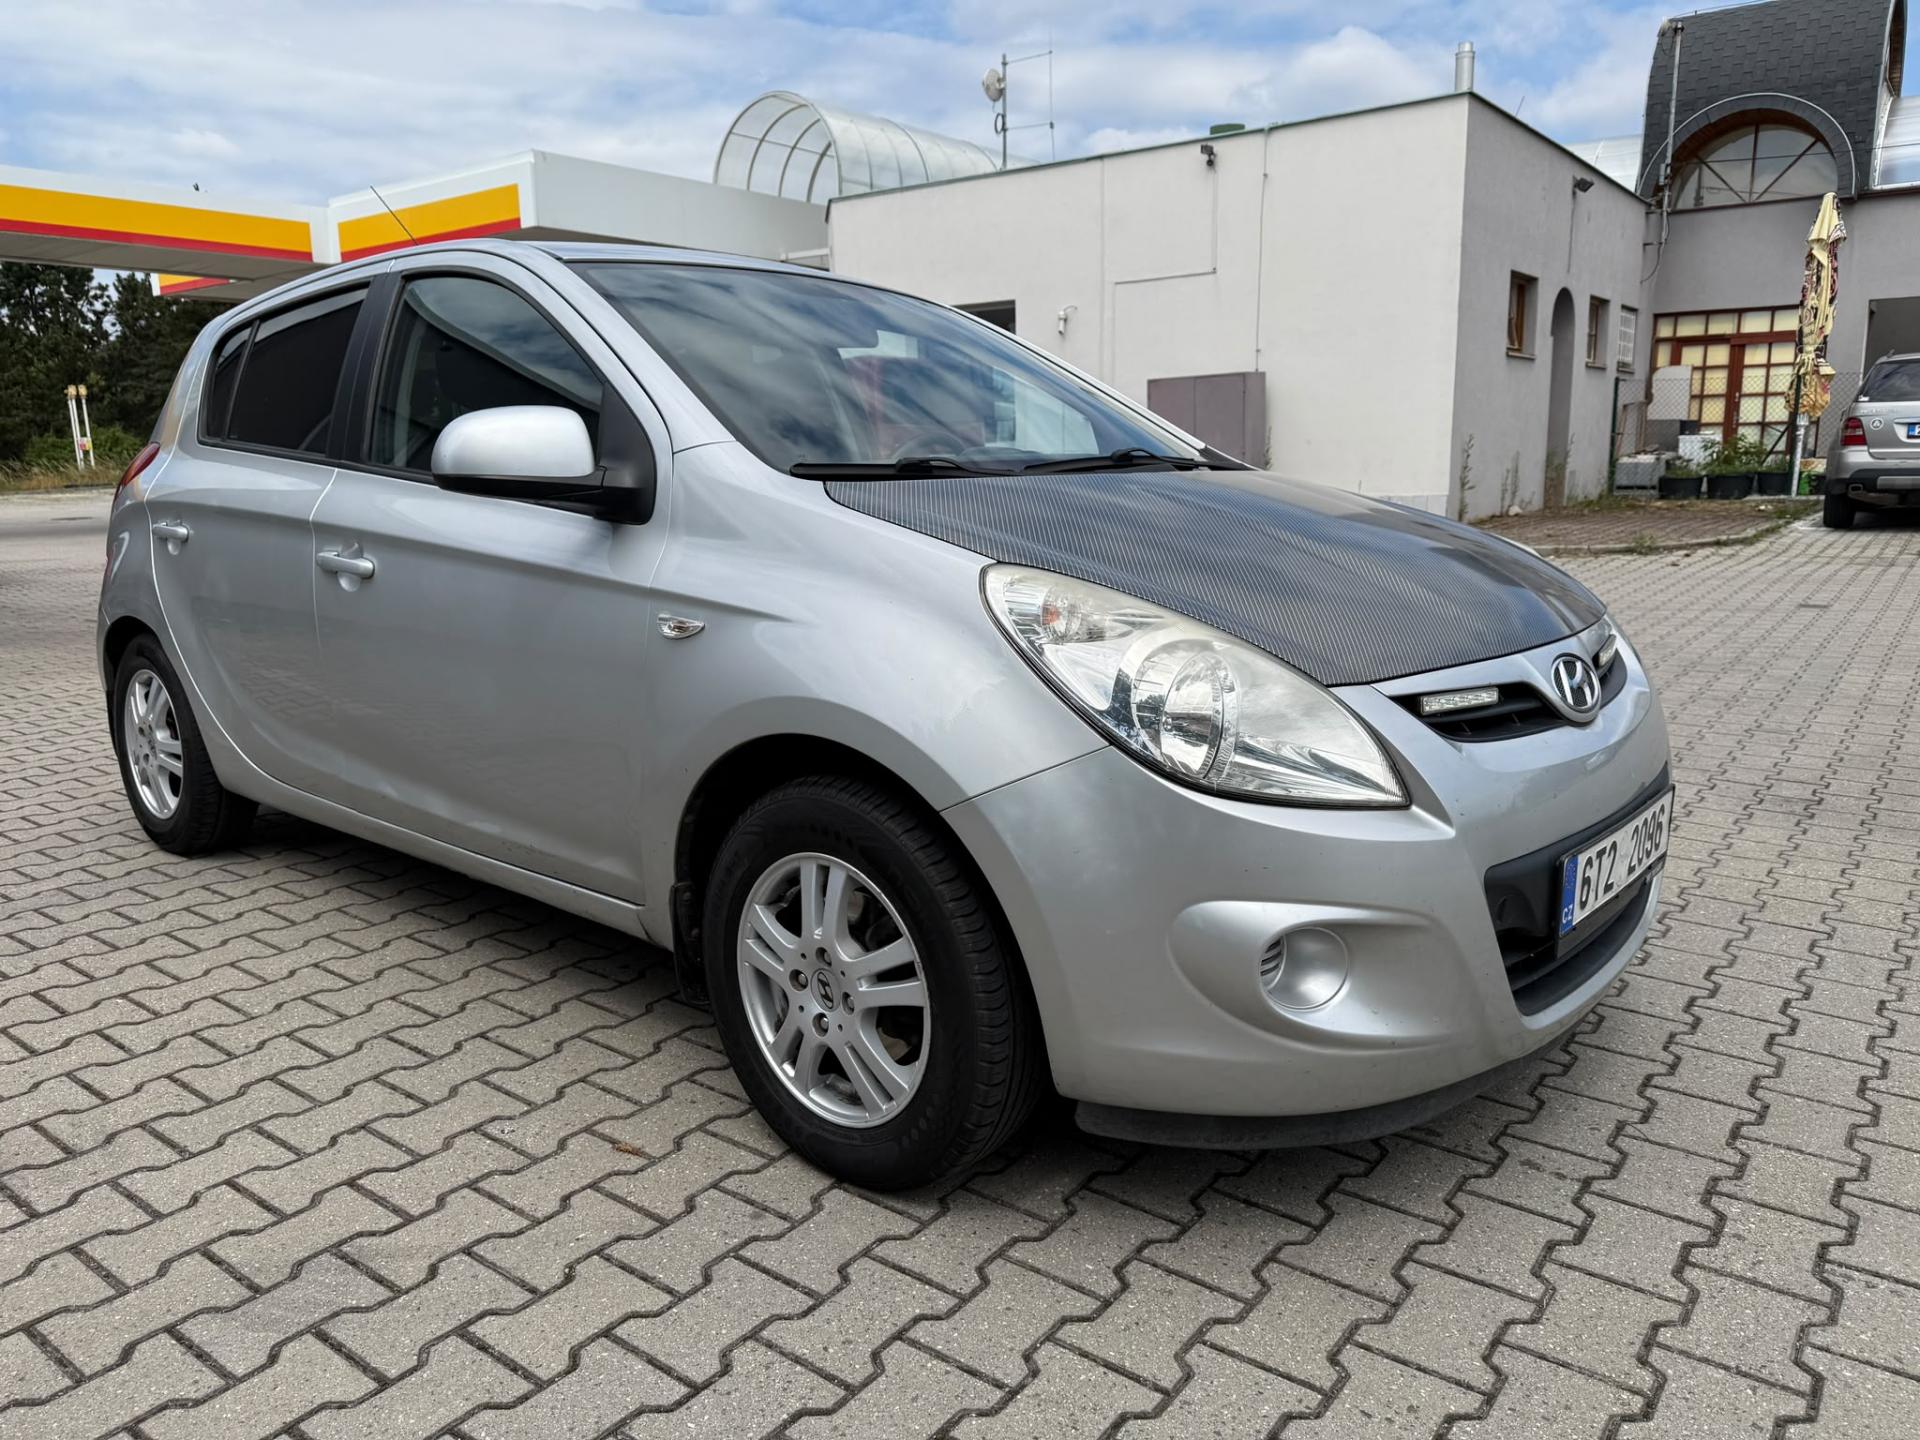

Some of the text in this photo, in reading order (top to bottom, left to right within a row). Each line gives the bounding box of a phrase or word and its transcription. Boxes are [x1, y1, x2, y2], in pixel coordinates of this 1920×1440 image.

[1579, 803, 1665, 910] 6T2 2096
[1562, 904, 1574, 925] CZ
